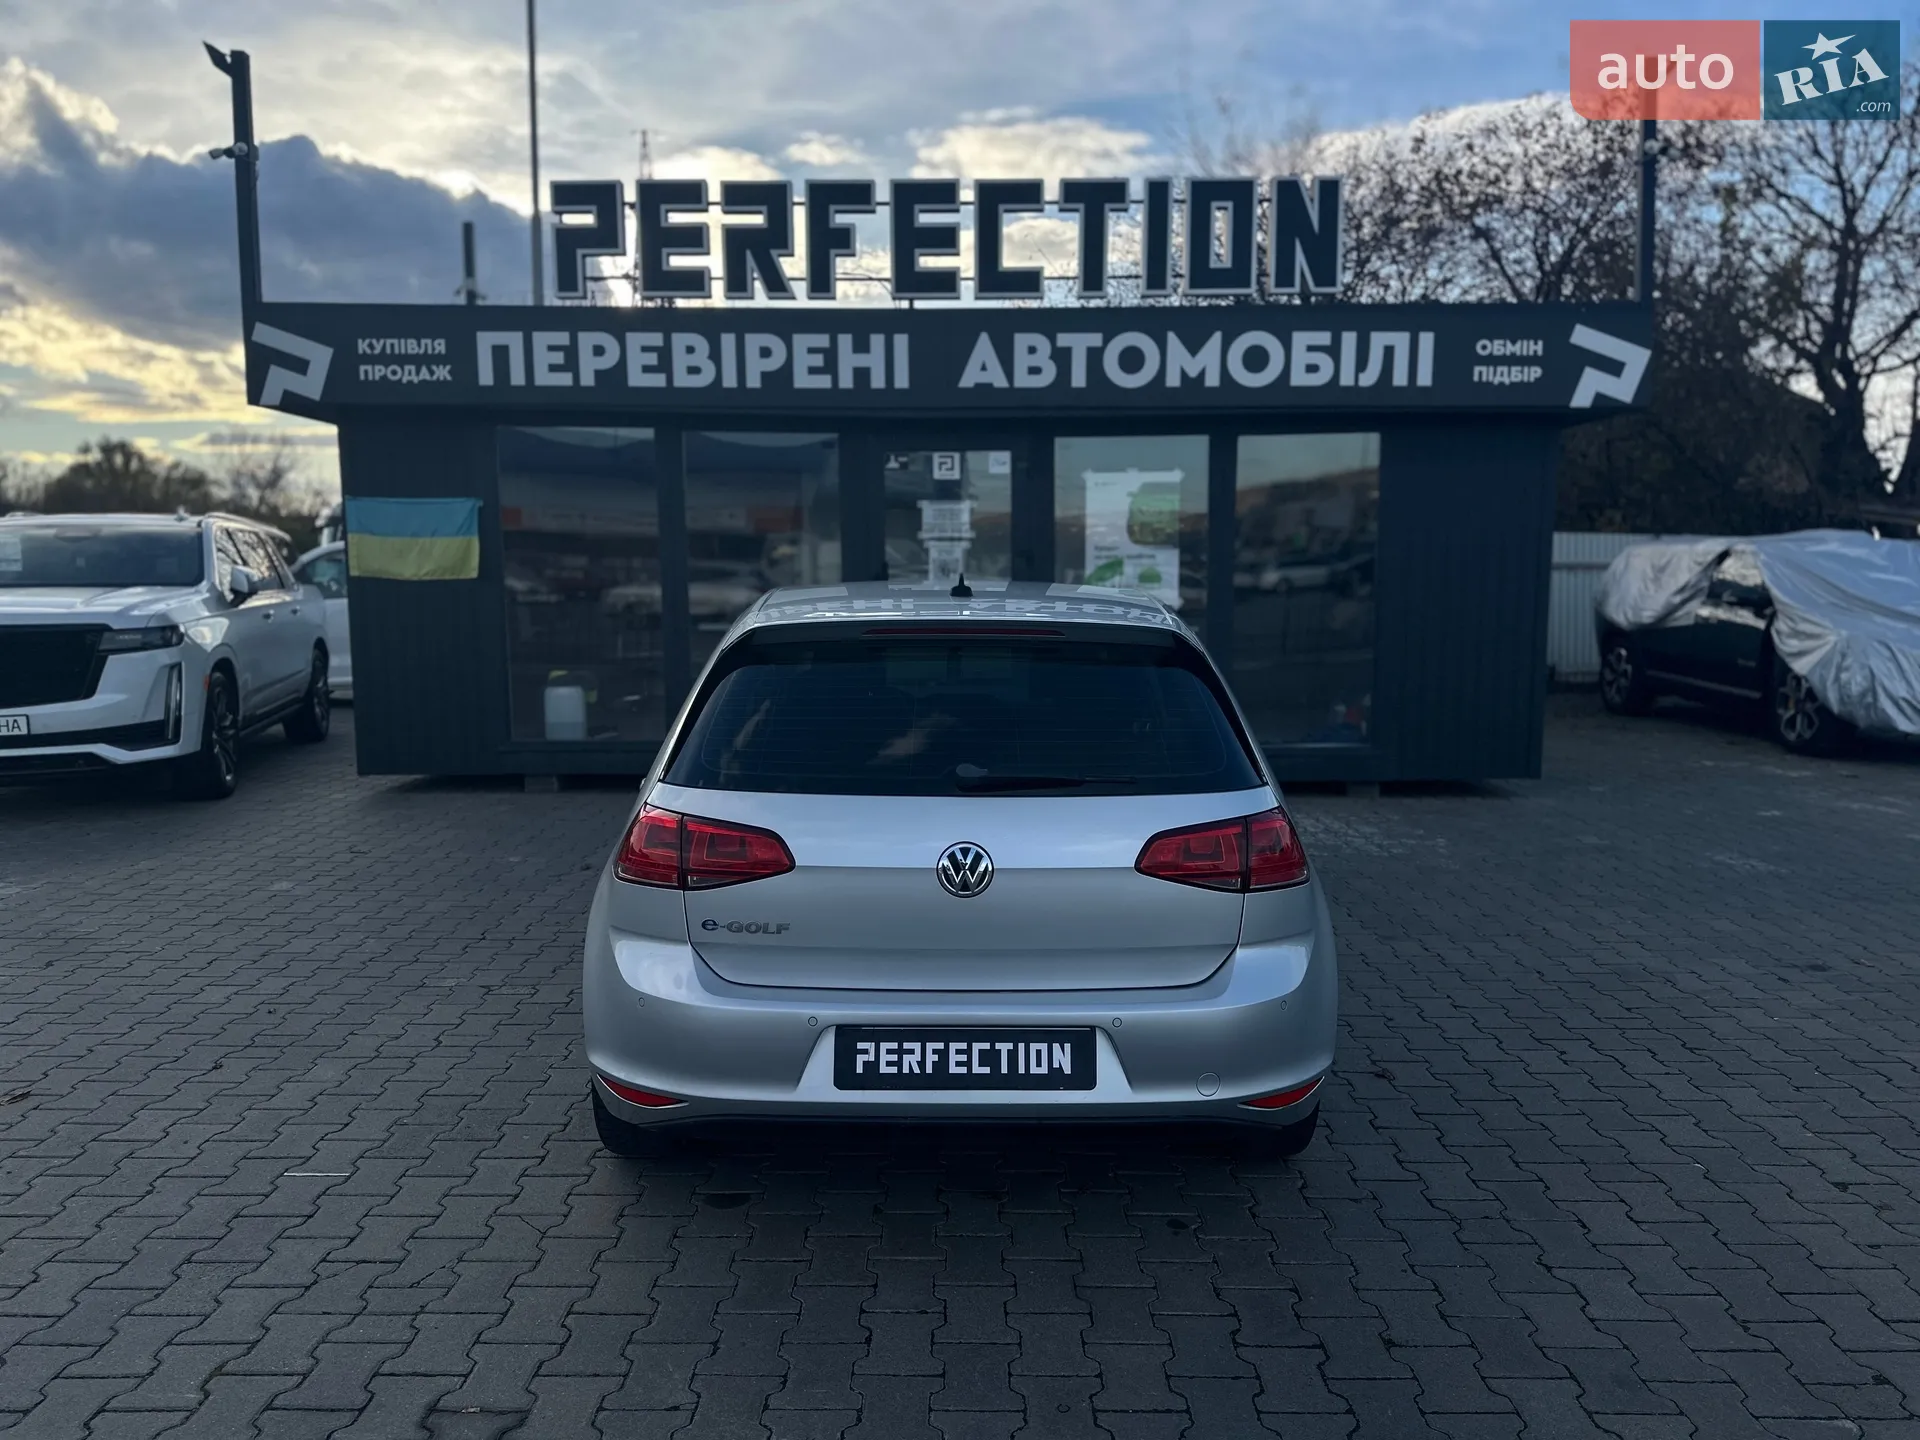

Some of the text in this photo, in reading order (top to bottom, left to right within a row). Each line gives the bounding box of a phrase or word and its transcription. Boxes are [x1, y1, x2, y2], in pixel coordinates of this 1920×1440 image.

[550, 178, 1343, 299] PERFECTION
[357, 338, 446, 356] КУПІВЛЯ
[1475, 338, 1544, 357] ОБМІН
[476, 331, 1436, 389] ПЕРЕВІРЕНІ АВТОМОБІЛІ
[358, 364, 453, 384] ПРОДАЖ
[1473, 364, 1543, 385] ПІДБІР
[701, 919, 790, 934] e-GOLF
[857, 1042, 1072, 1074] PERFECTION
